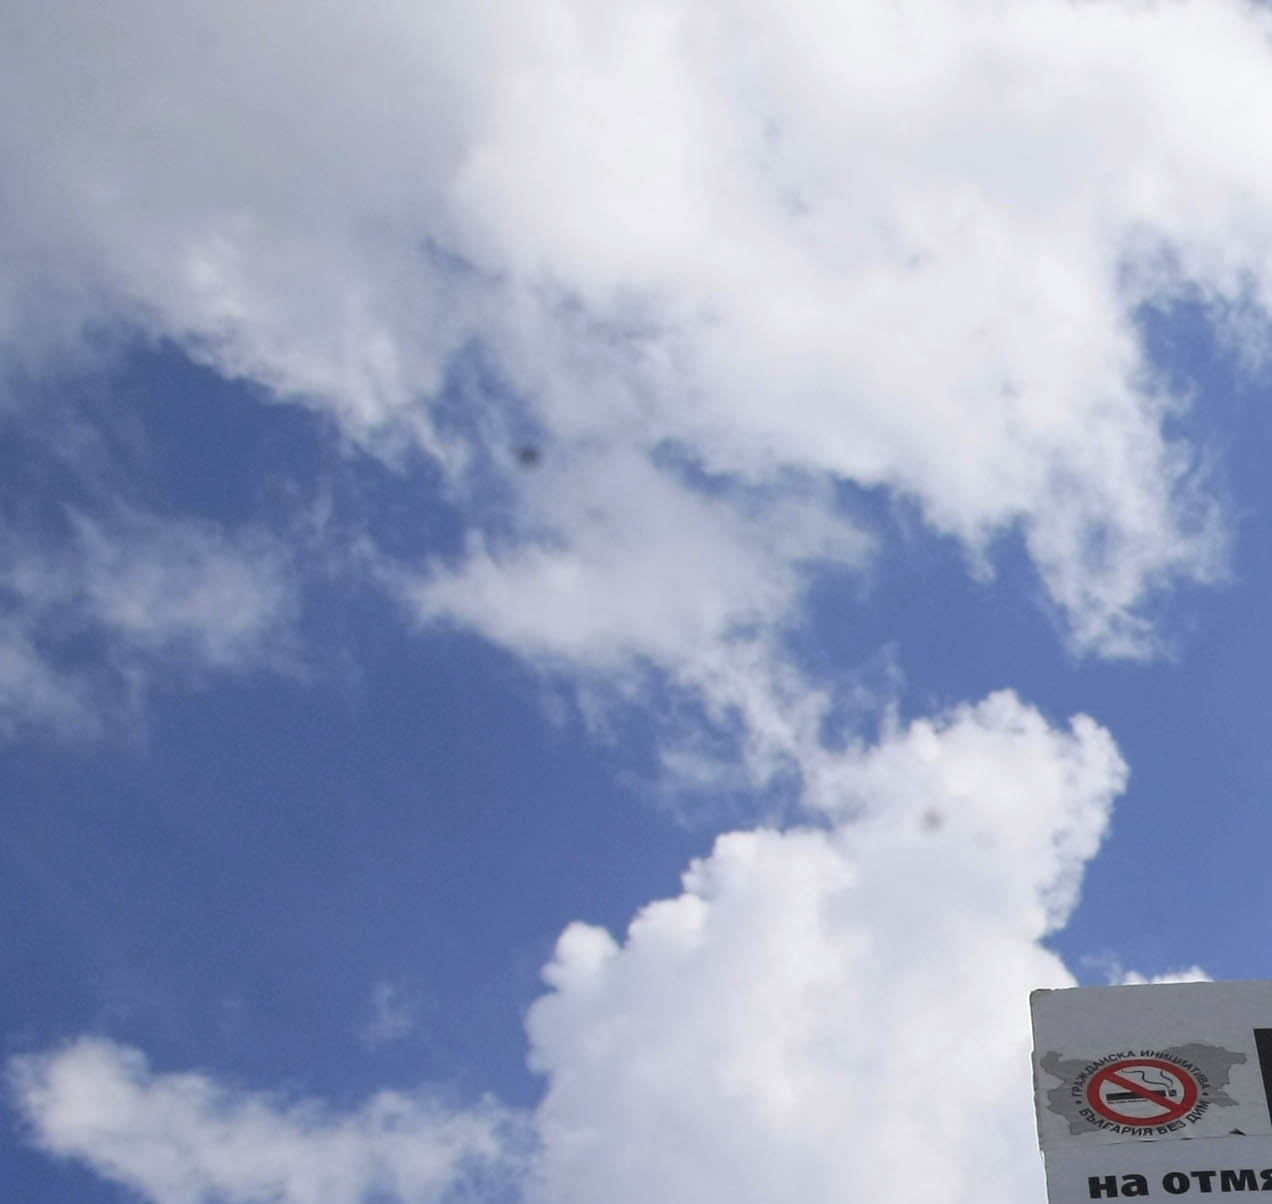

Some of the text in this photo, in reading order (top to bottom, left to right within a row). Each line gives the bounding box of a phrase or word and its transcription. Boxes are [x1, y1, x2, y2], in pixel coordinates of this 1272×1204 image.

[1071, 1050, 1136, 1097] ГРАЖДАНСКА
[1079, 1100, 1212, 1136] БЪЛГАРИЯ БЕЗ ДИМ
[1088, 1167, 1149, 1200] на
